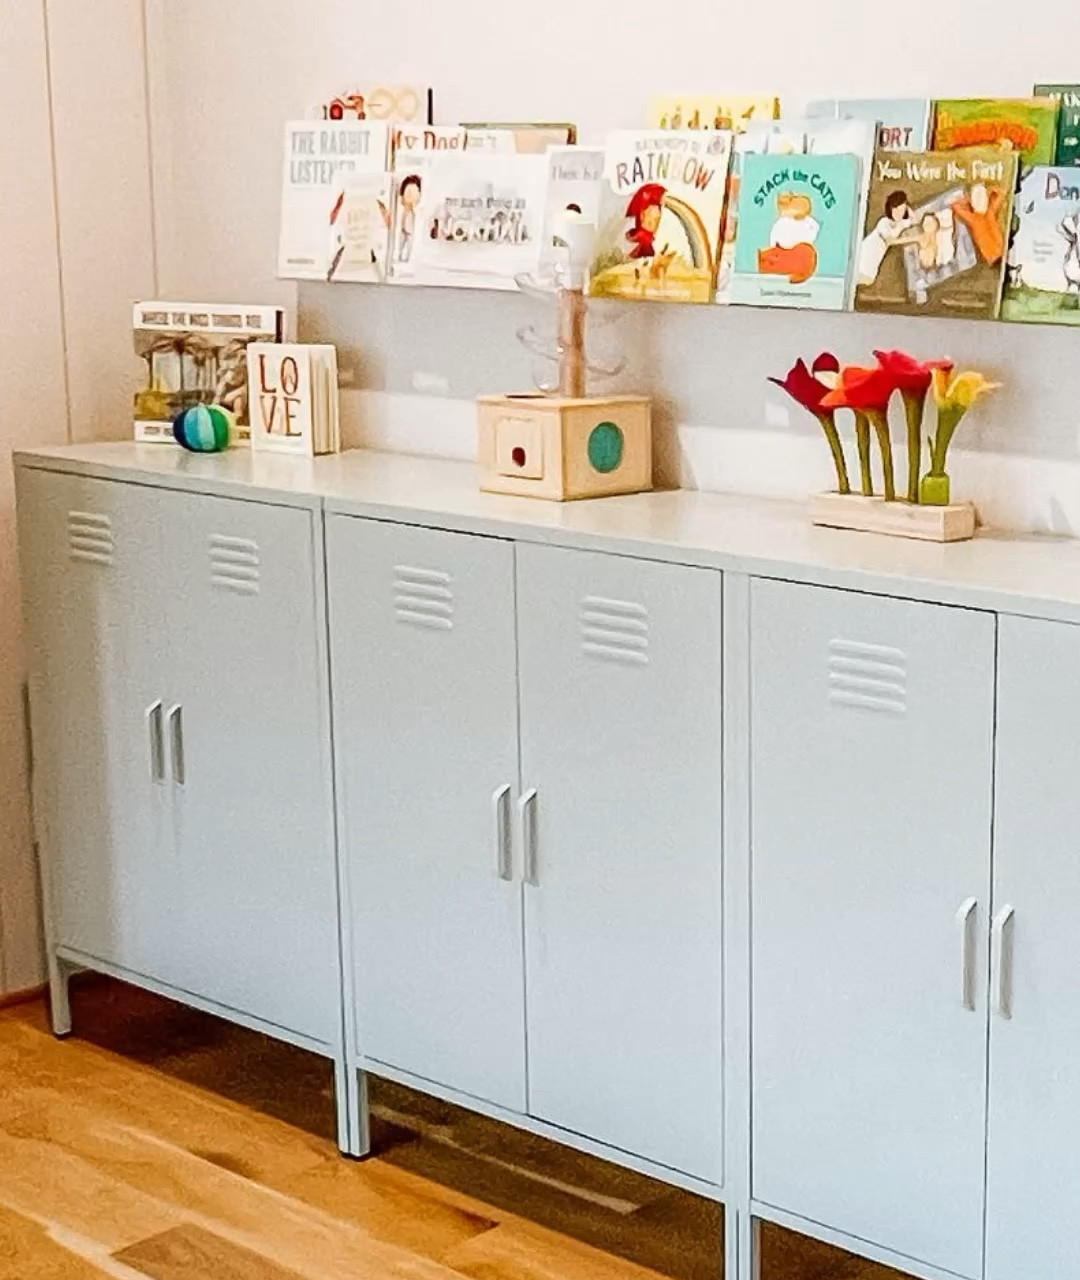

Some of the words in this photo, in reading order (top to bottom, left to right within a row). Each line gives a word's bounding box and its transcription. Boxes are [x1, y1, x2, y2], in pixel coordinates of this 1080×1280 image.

[291, 131, 315, 154] THE
[320, 131, 370, 154] RABBIT
[877, 160, 901, 181] You
[753, 168, 790, 207] STACK
[810, 173, 837, 210] CATS
